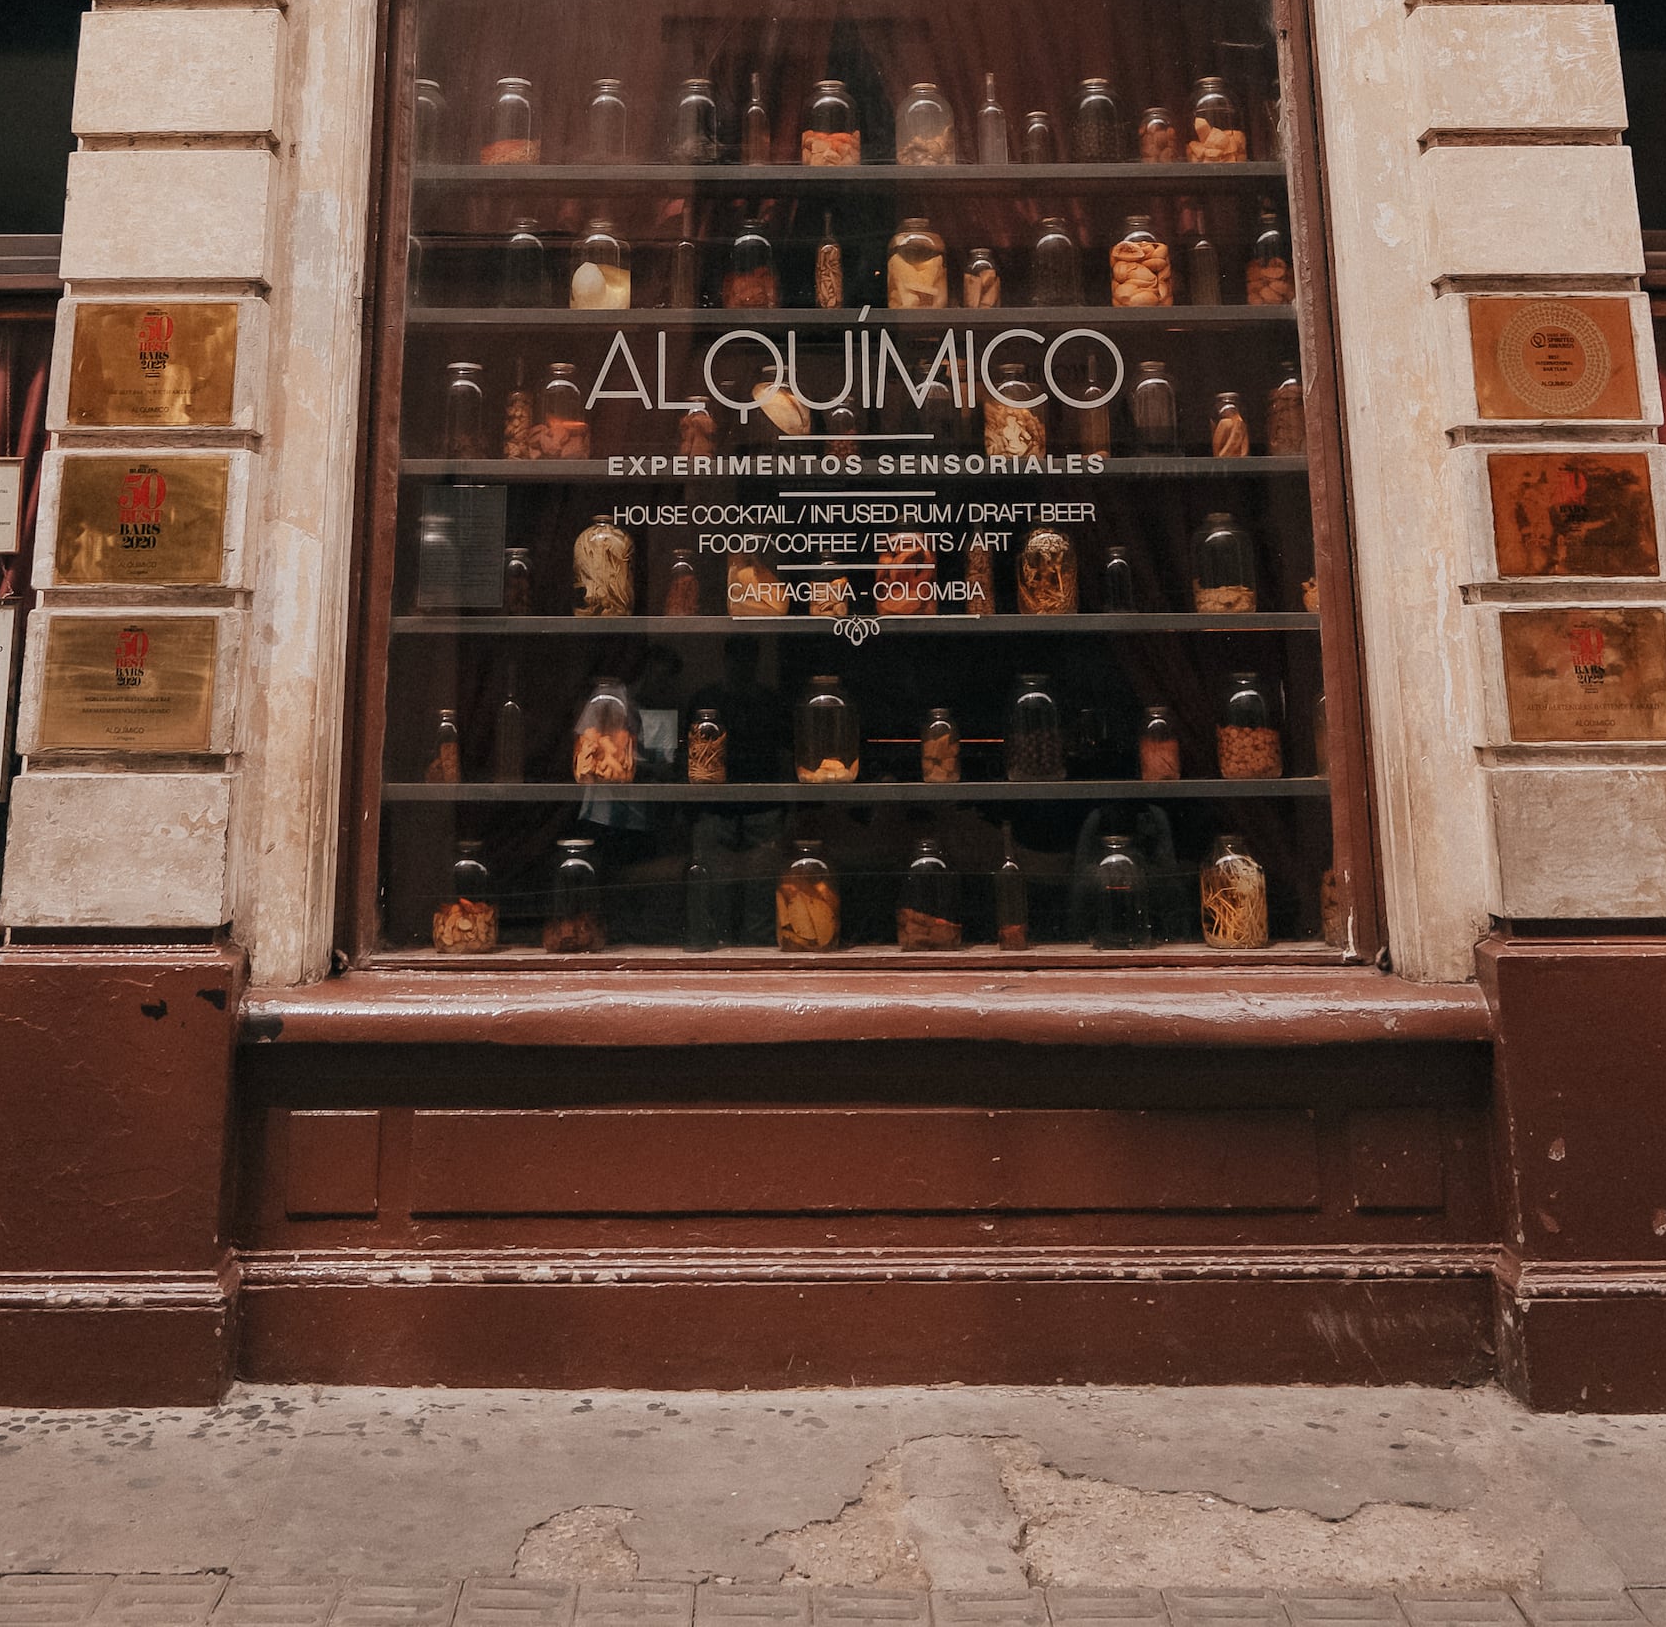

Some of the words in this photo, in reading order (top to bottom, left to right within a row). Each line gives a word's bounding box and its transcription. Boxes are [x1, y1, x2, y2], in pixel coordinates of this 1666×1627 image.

[139, 316, 174, 342] 50
[139, 341, 169, 352] BEST
[139, 351, 170, 360] BARS
[140, 360, 167, 370] 2023
[585, 304, 1125, 425] ALQUÍMICO
[608, 454, 863, 476] EXPERIMENTOS
[878, 453, 1105, 475] SENSORIALES
[118, 474, 167, 509] 50
[119, 509, 162, 523] BEST
[614, 505, 688, 525] HOUSE
[691, 504, 795, 525] COCKTAIL
[810, 503, 899, 524] INFUSED
[903, 503, 952, 523] RUM
[968, 503, 1036, 523] DRAFT
[1040, 502, 1096, 522] BEER
[119, 523, 161, 535] BARS
[123, 535, 157, 549] 2020
[698, 533, 760, 554] FOOD
[775, 533, 858, 553] COFFEE
[873, 532, 954, 552] EVENTS
[970, 532, 1012, 552] ART
[727, 582, 856, 602] CARTAGENA
[872, 581, 986, 601] COLOMBIA
[115, 632, 149, 658] 50
[1570, 627, 1605, 654] 50
[116, 667, 145, 677] BARS
[1574, 664, 1606, 674] BARS
[116, 676, 141, 686] 2020
[1577, 674, 1605, 684] 2022
